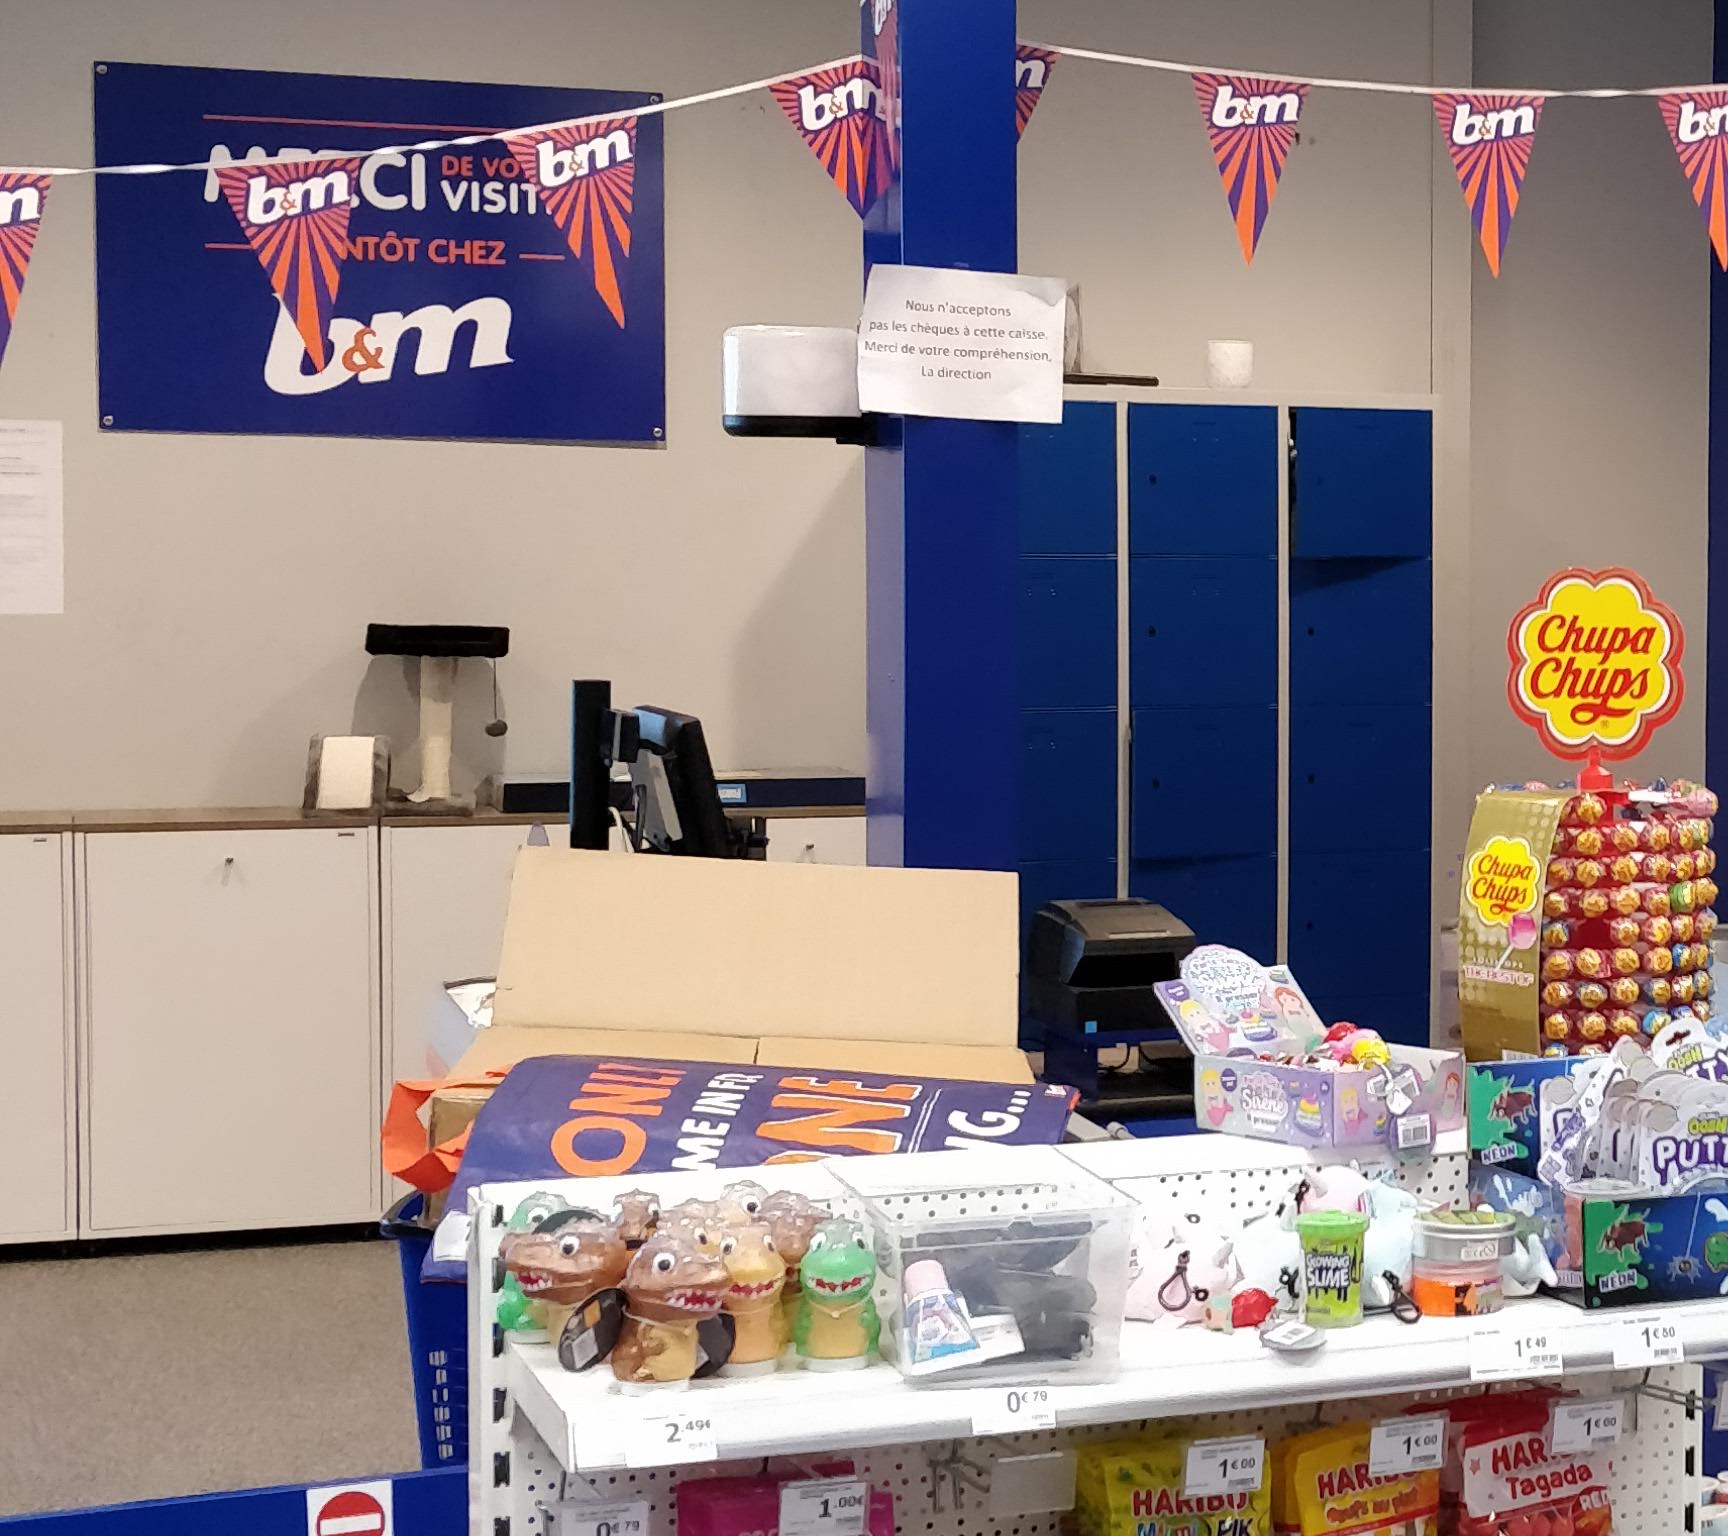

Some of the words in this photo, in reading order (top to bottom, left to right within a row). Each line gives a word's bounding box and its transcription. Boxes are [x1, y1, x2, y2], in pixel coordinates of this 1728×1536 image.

[1210, 82, 1300, 130] b&m
[1452, 102, 1535, 145] b&m
[441, 155, 474, 178] DE
[535, 129, 634, 188] b&m
[246, 169, 354, 224] b&m
[440, 179, 552, 215] VISIT
[341, 231, 420, 263] NTÔT
[428, 238, 507, 265] CHEZ
[905, 299, 935, 313] Nous
[937, 301, 1012, 317] n'acceptons
[264, 293, 514, 395] b&m
[868, 321, 889, 333] pas
[892, 319, 908, 333] les
[910, 322, 960, 337] chèques
[963, 325, 971, 337] à
[973, 327, 1005, 339] cette
[864, 340, 898, 353] Merci
[901, 343, 916, 355] de
[919, 345, 950, 357] votre
[921, 366, 934, 377] La
[937, 366, 992, 380] direction
[1537, 613, 1657, 656] Chupa
[1530, 657, 1650, 725] Chups
[1476, 852, 1535, 882] Chupa
[1470, 875, 1529, 916] Chups
[1306, 1266, 1350, 1289] SLIME
[1490, 1437, 1551, 1475] HAR
[1505, 1463, 1594, 1499] Tagada
